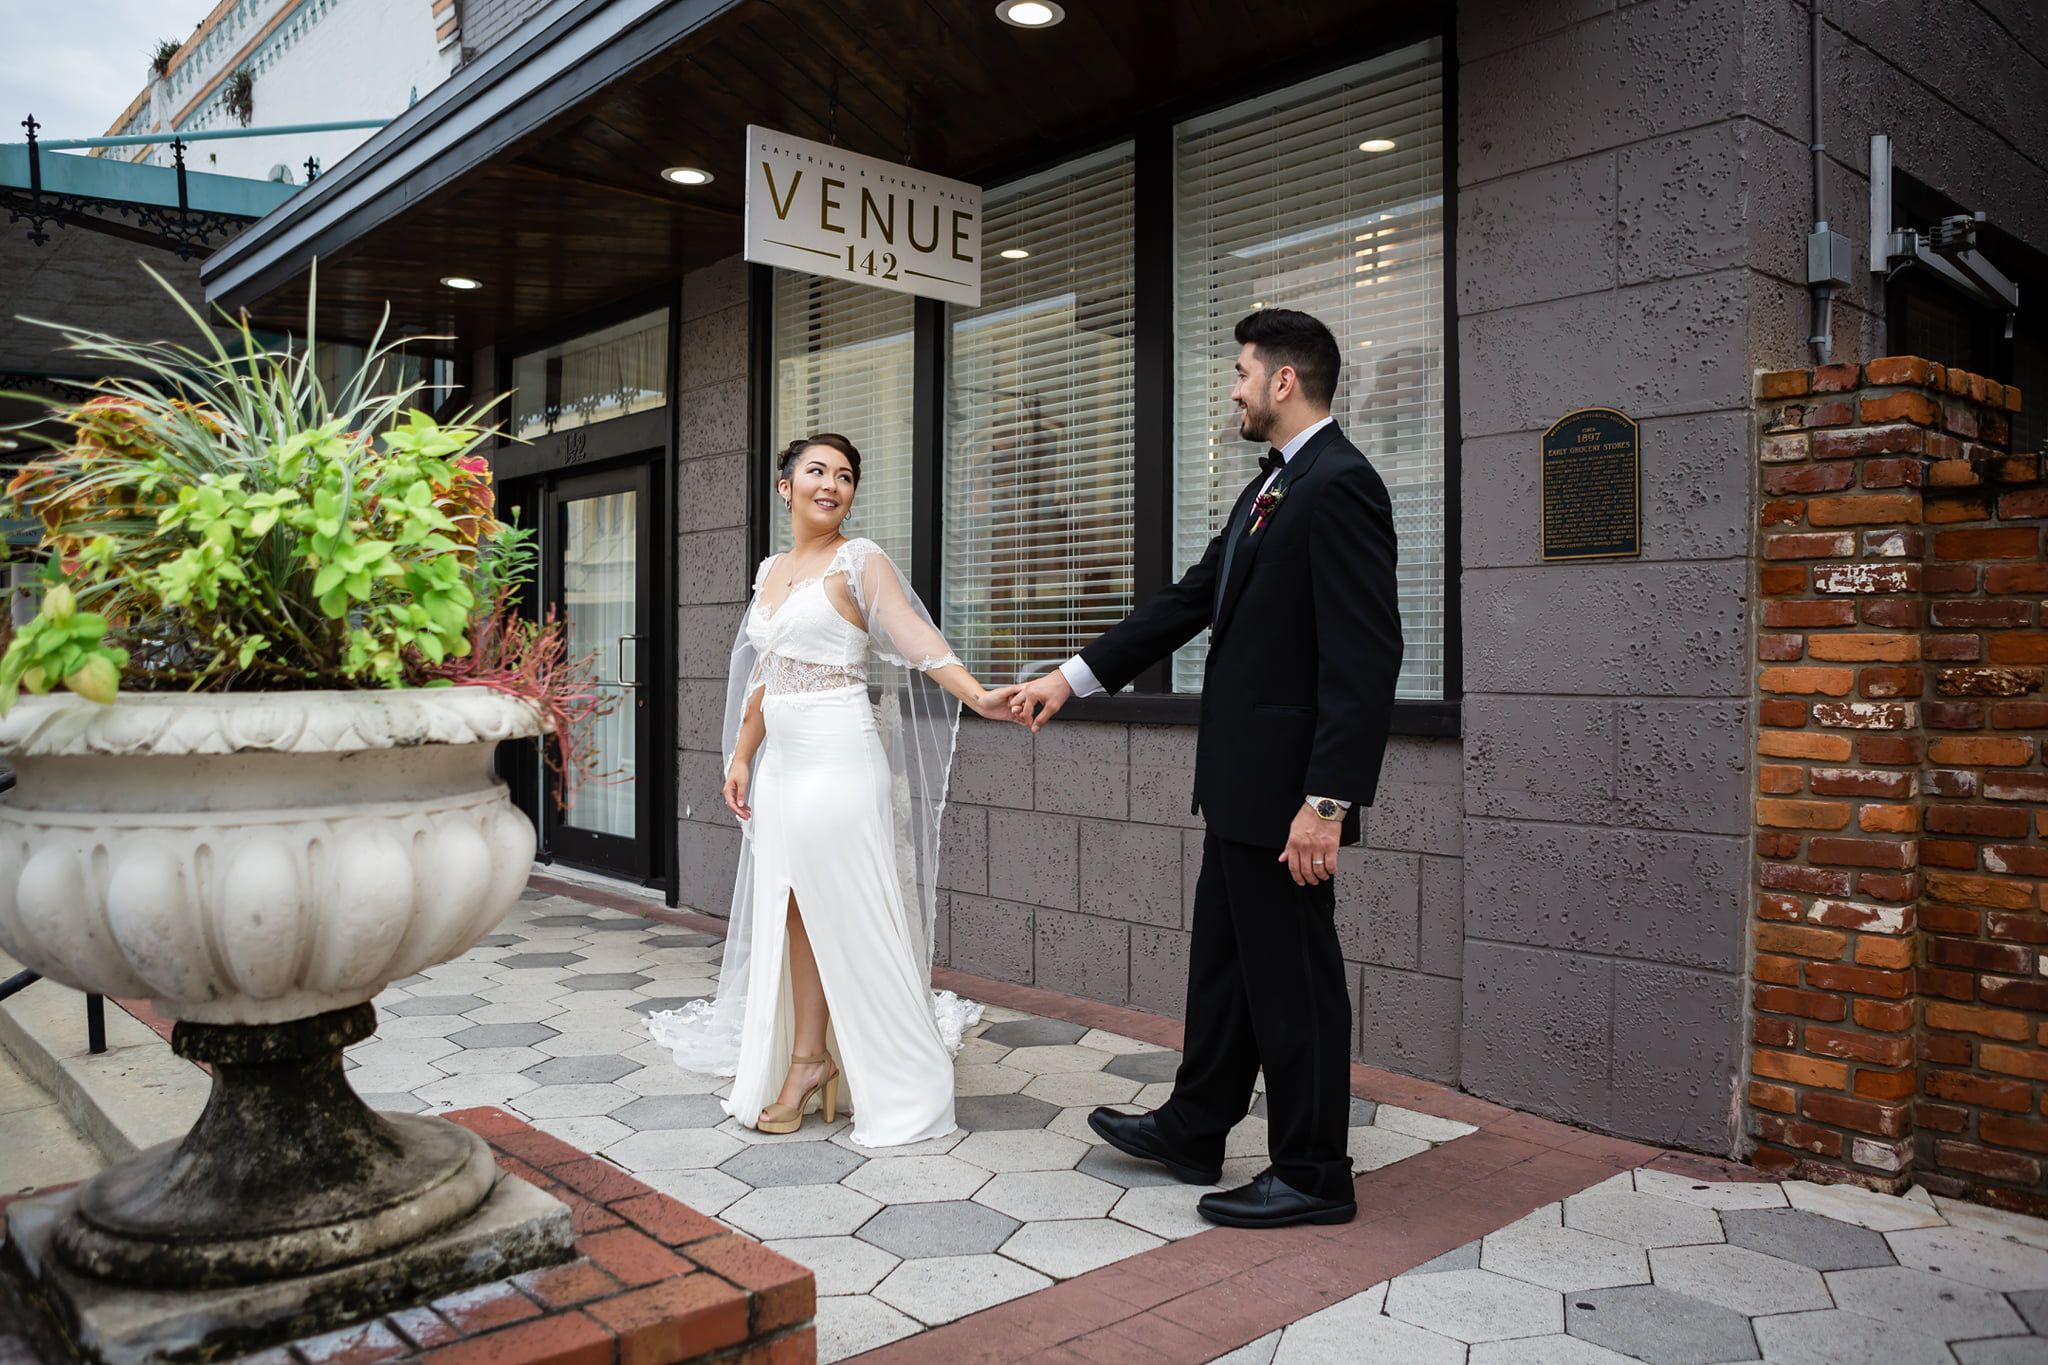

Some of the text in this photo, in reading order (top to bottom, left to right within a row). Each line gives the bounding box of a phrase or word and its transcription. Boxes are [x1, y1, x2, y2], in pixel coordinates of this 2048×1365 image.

[761, 144, 975, 205] CATERING & EVENT HALL
[762, 161, 974, 263] VENUE
[844, 244, 899, 281] 142
[1548, 441, 1630, 457] EARLY GROCERY STORES
[1576, 432, 1601, 444] 1897
